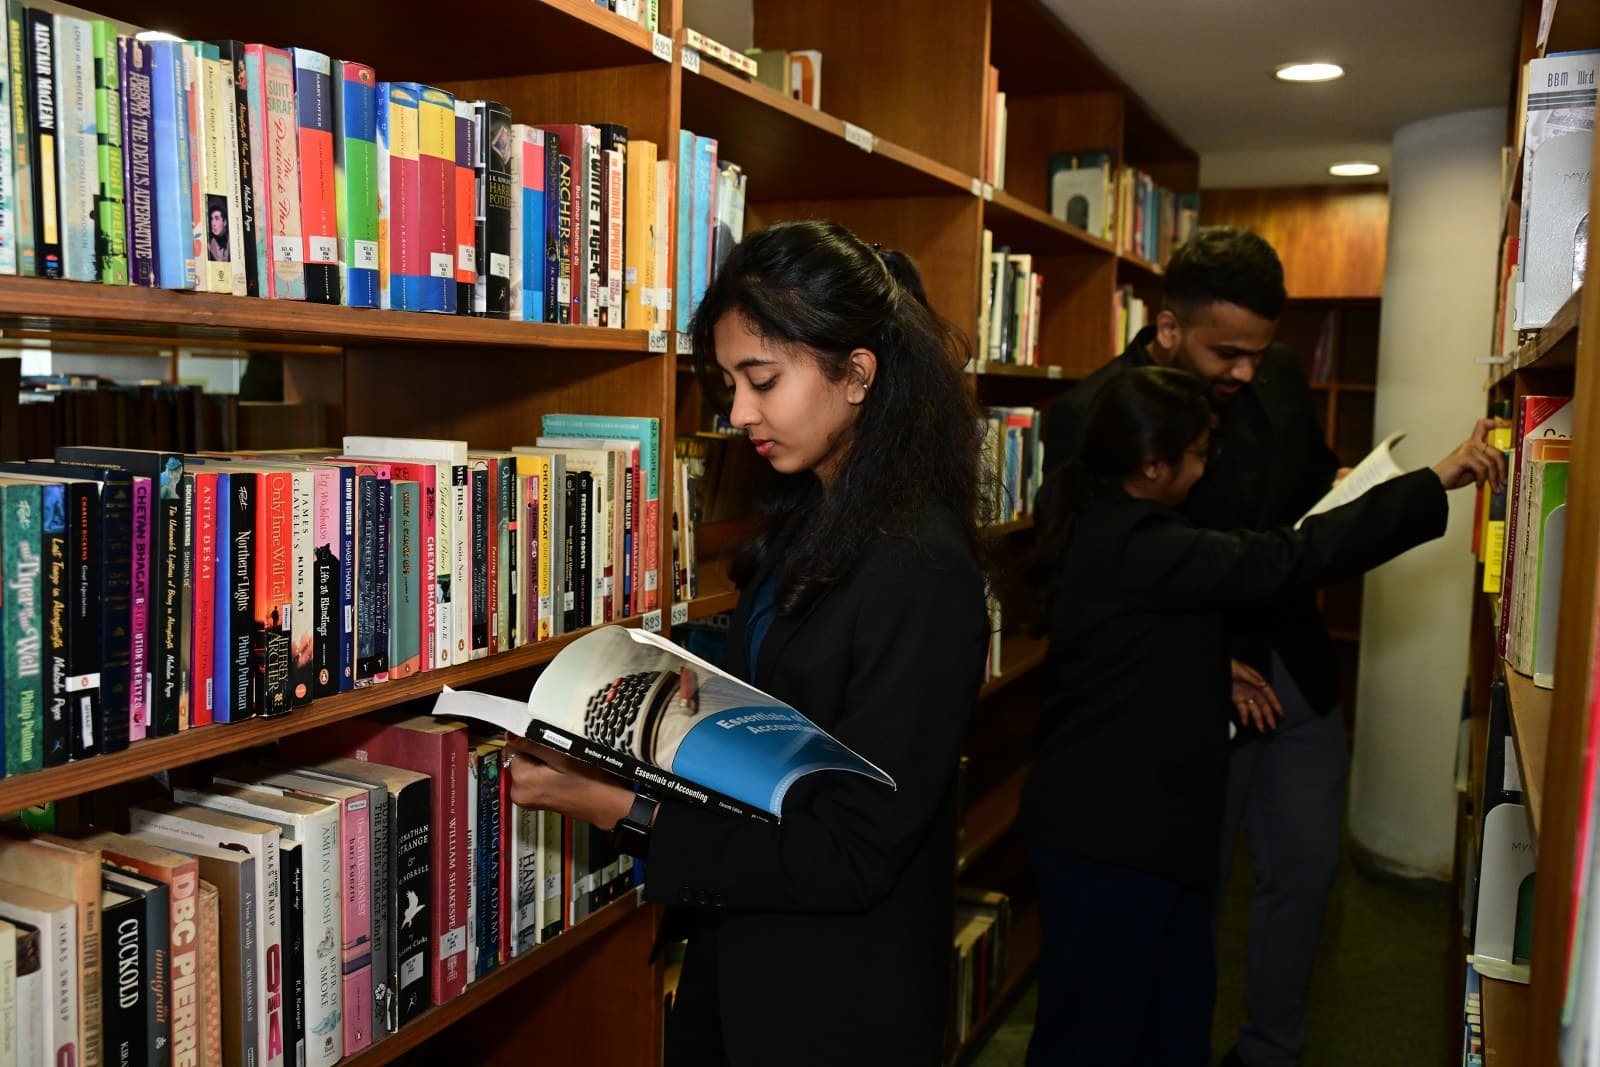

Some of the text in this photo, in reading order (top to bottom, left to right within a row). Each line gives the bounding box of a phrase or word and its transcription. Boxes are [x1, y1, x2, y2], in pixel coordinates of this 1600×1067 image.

[35, 22, 51, 75] ALISTAIR
[655, 38, 671, 57] 823
[267, 80, 290, 100] SUJIT
[1547, 71, 1569, 87] BBM
[131, 119, 147, 142] THE
[267, 96, 294, 115] SARAF
[106, 40, 125, 265] NICK HORNBY HIGH FIDELITY
[273, 118, 287, 195] Peacock
[282, 156, 296, 179] The
[133, 187, 153, 259] ALTERNATIVE
[560, 160, 571, 239] ARCHER
[589, 157, 601, 276] WHITE TIGER
[610, 169, 622, 271] ACCIDENTAL APPRENTICE
[574, 256, 580, 266] do
[650, 335, 666, 349] 823
[650, 420, 659, 442] SIX
[184, 484, 192, 515] SOCIALITE
[345, 478, 353, 500] SHOW
[427, 487, 435, 496] 2
[456, 466, 465, 522] MISTRESS
[542, 463, 550, 500] CHETAN
[625, 472, 633, 501] ALISTAIR
[168, 505, 178, 517] The
[202, 486, 212, 579] ANITA DESAI
[292, 478, 300, 550] CLAVELL'S
[301, 492, 310, 534] JAMES
[345, 500, 353, 535] BUSINESS
[648, 503, 657, 539] VIKAS
[135, 486, 149, 595] CHETAN BHAGAT
[183, 551, 191, 577] SHOBHA
[269, 476, 287, 603] Only Time Will Tell
[81, 565, 89, 581] Great
[166, 580, 177, 588] of
[234, 529, 252, 612] Northern Lights
[427, 536, 436, 628] CHETAN BHAGAT
[9, 555, 41, 679] Tiger Well
[80, 582, 89, 617] Expectations
[166, 589, 177, 606] Being
[317, 565, 331, 637] Life at Blandings
[644, 615, 660, 631] 823
[671, 609, 687, 623] 839
[49, 538, 66, 721] Last Tango in Aberystwyth Malcolm Pryce
[166, 654, 175, 680] Malcolm
[235, 635, 250, 710] Philip Pullman
[268, 631, 280, 692] ARCHER
[277, 633, 290, 682] JEFFREY
[165, 682, 175, 698] Pryce
[18, 689, 36, 762] Philip Pullman
[605, 754, 624, 769] Anthony
[634, 765, 667, 787] Essentials
[667, 779, 675, 790] of
[674, 780, 709, 804] Accounting
[448, 817, 458, 869] WILLIAM
[266, 843, 276, 928] VIKAS SWARUP
[320, 827, 332, 925] AMITAV GHOSH
[347, 838, 356, 903] hari kunzru
[356, 835, 368, 916] IMPRESSIONIST
[373, 805, 382, 952] THE LADIES GRACE ADIEU
[490, 799, 500, 944] DOUGLAS ADAMS
[447, 872, 457, 933] SHAKESPE
[83, 932, 99, 970] ELEVEN
[243, 921, 253, 950] Family
[58, 922, 69, 1023] VIKAS SWARUP
[117, 918, 139, 1009] CUCKOLD
[151, 949, 168, 1024] immigrant
[172, 871, 197, 1067] DBC PIERRE
[319, 966, 330, 1009] SMOKE
[328, 955, 338, 1007] RIVER OF
